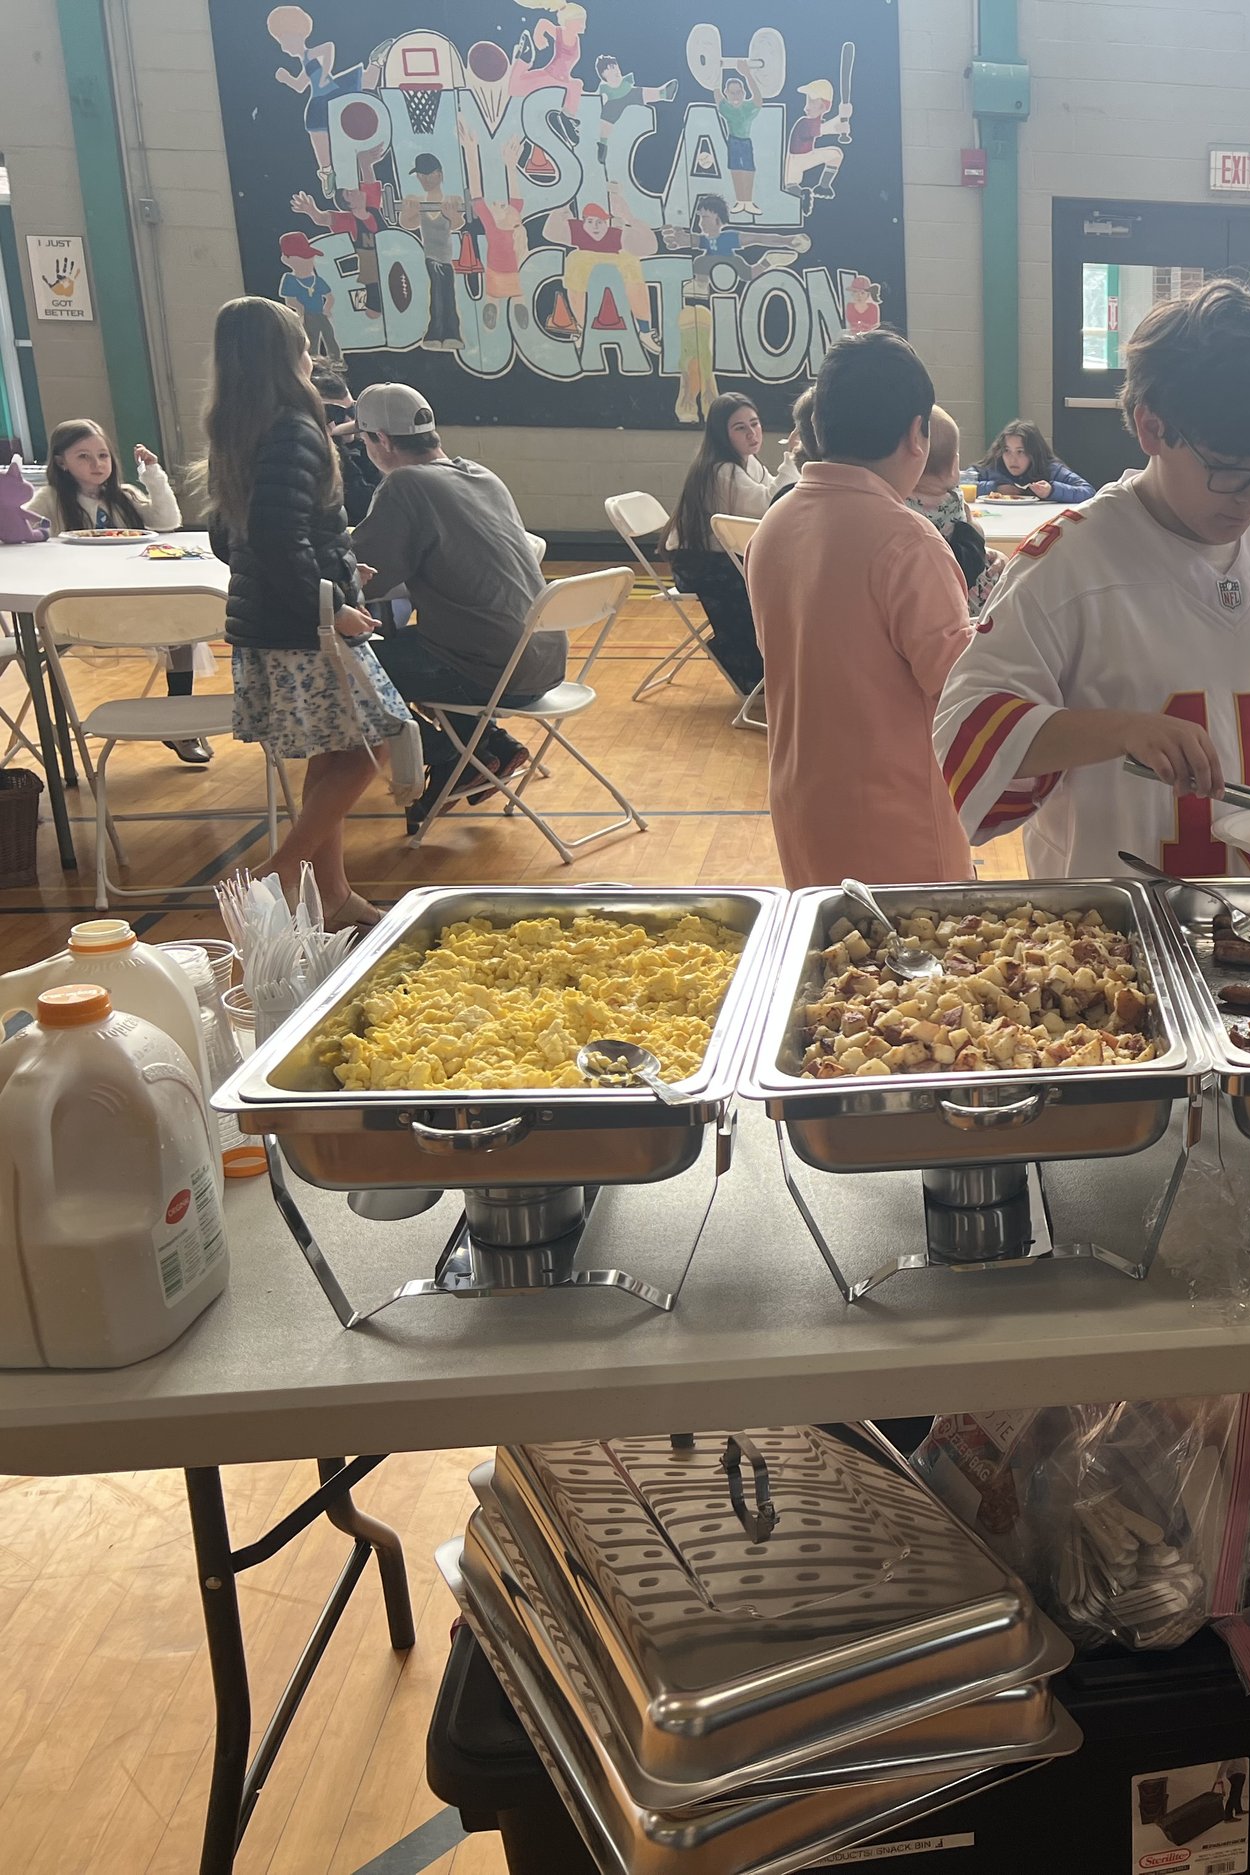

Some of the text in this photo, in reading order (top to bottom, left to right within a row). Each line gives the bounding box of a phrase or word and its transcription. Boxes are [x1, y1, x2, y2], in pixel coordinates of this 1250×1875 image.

[326, 86, 805, 230] PHYSICAL
[45, 239, 72, 248] JUST
[51, 299, 73, 308] GOT
[44, 308, 84, 317] BETTER
[1222, 591, 1241, 606] NFL
[967, 1455, 991, 1481] BAG
[876, 1843, 911, 1856] SNACK
[914, 1840, 932, 1850] BIN
[1144, 1852, 1184, 1867] Sterilite
